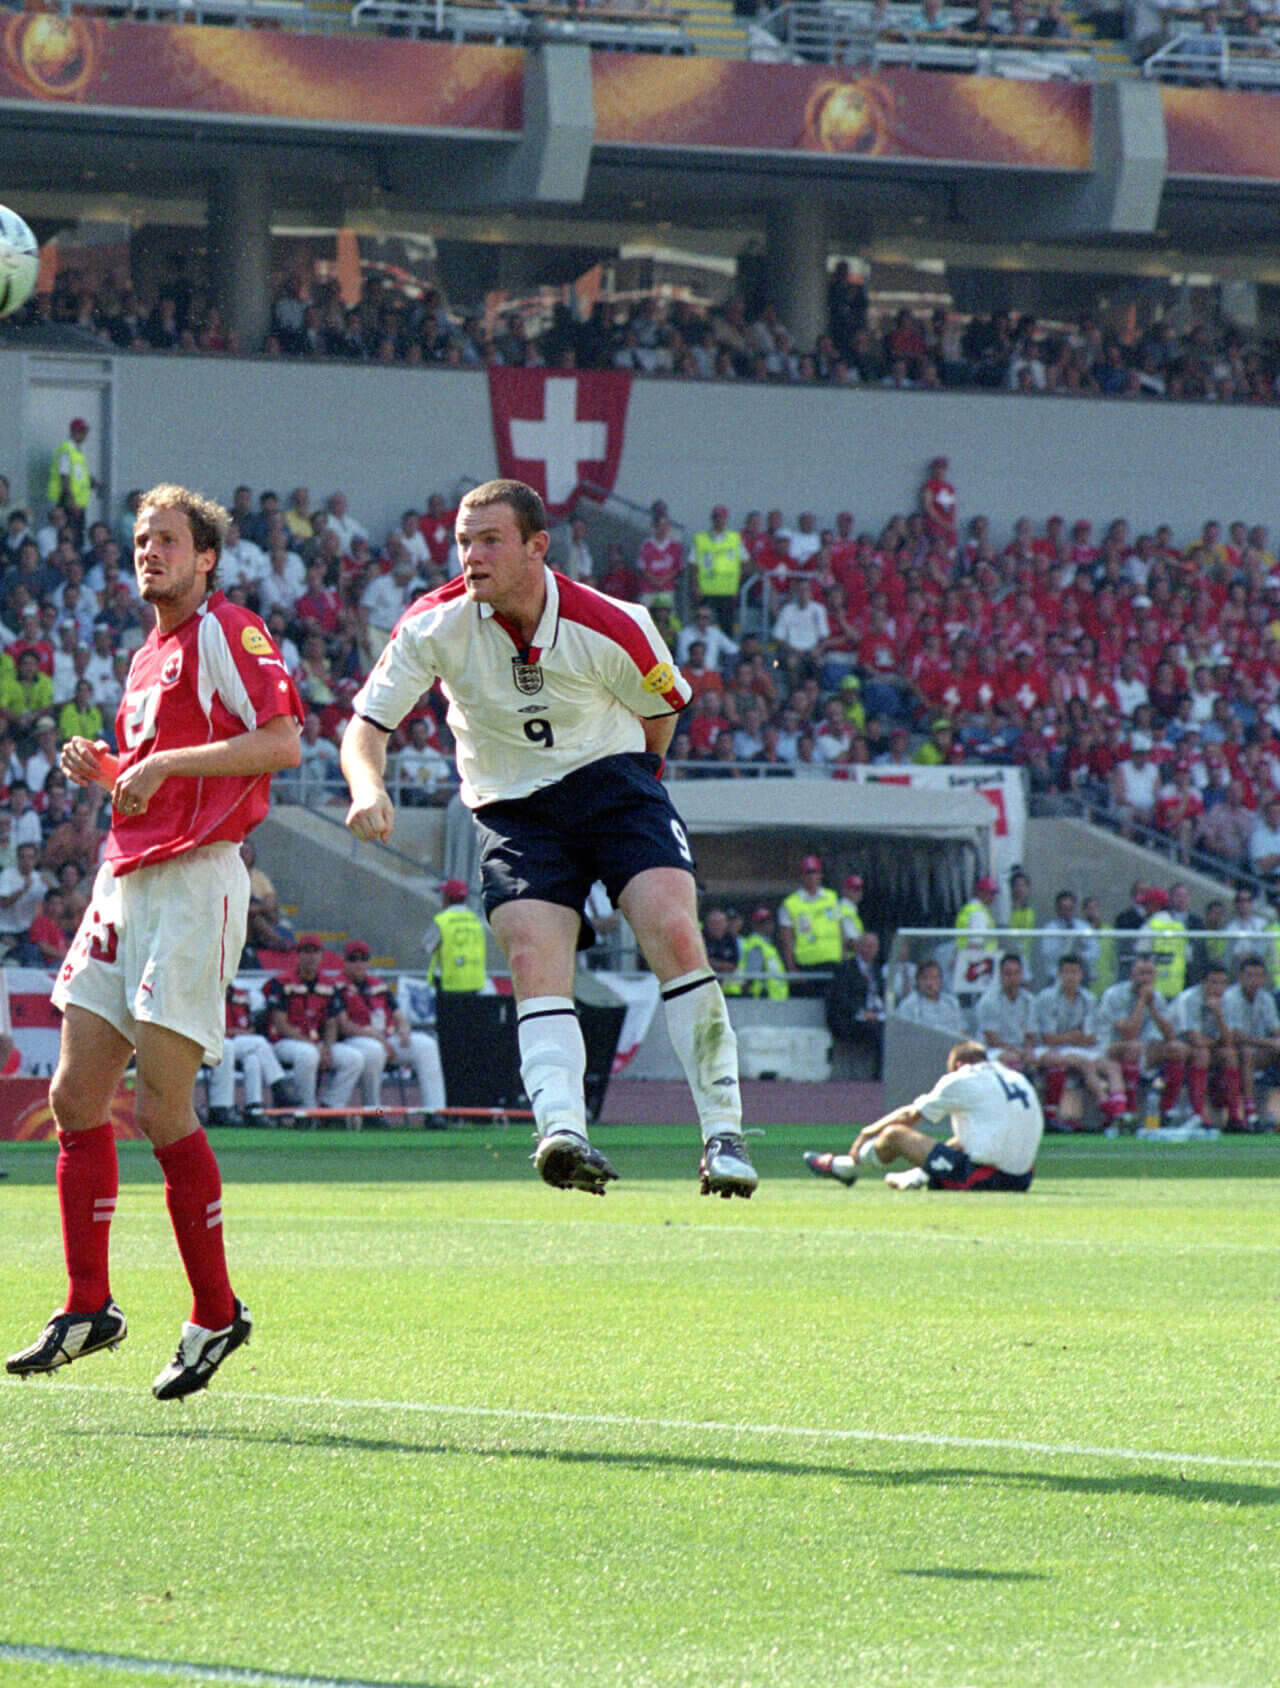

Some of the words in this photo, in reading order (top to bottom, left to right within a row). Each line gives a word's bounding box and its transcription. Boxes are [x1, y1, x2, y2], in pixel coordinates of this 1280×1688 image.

[523, 718, 554, 748] 9
[671, 819, 693, 862] 9
[995, 1071, 1030, 1109] 4
